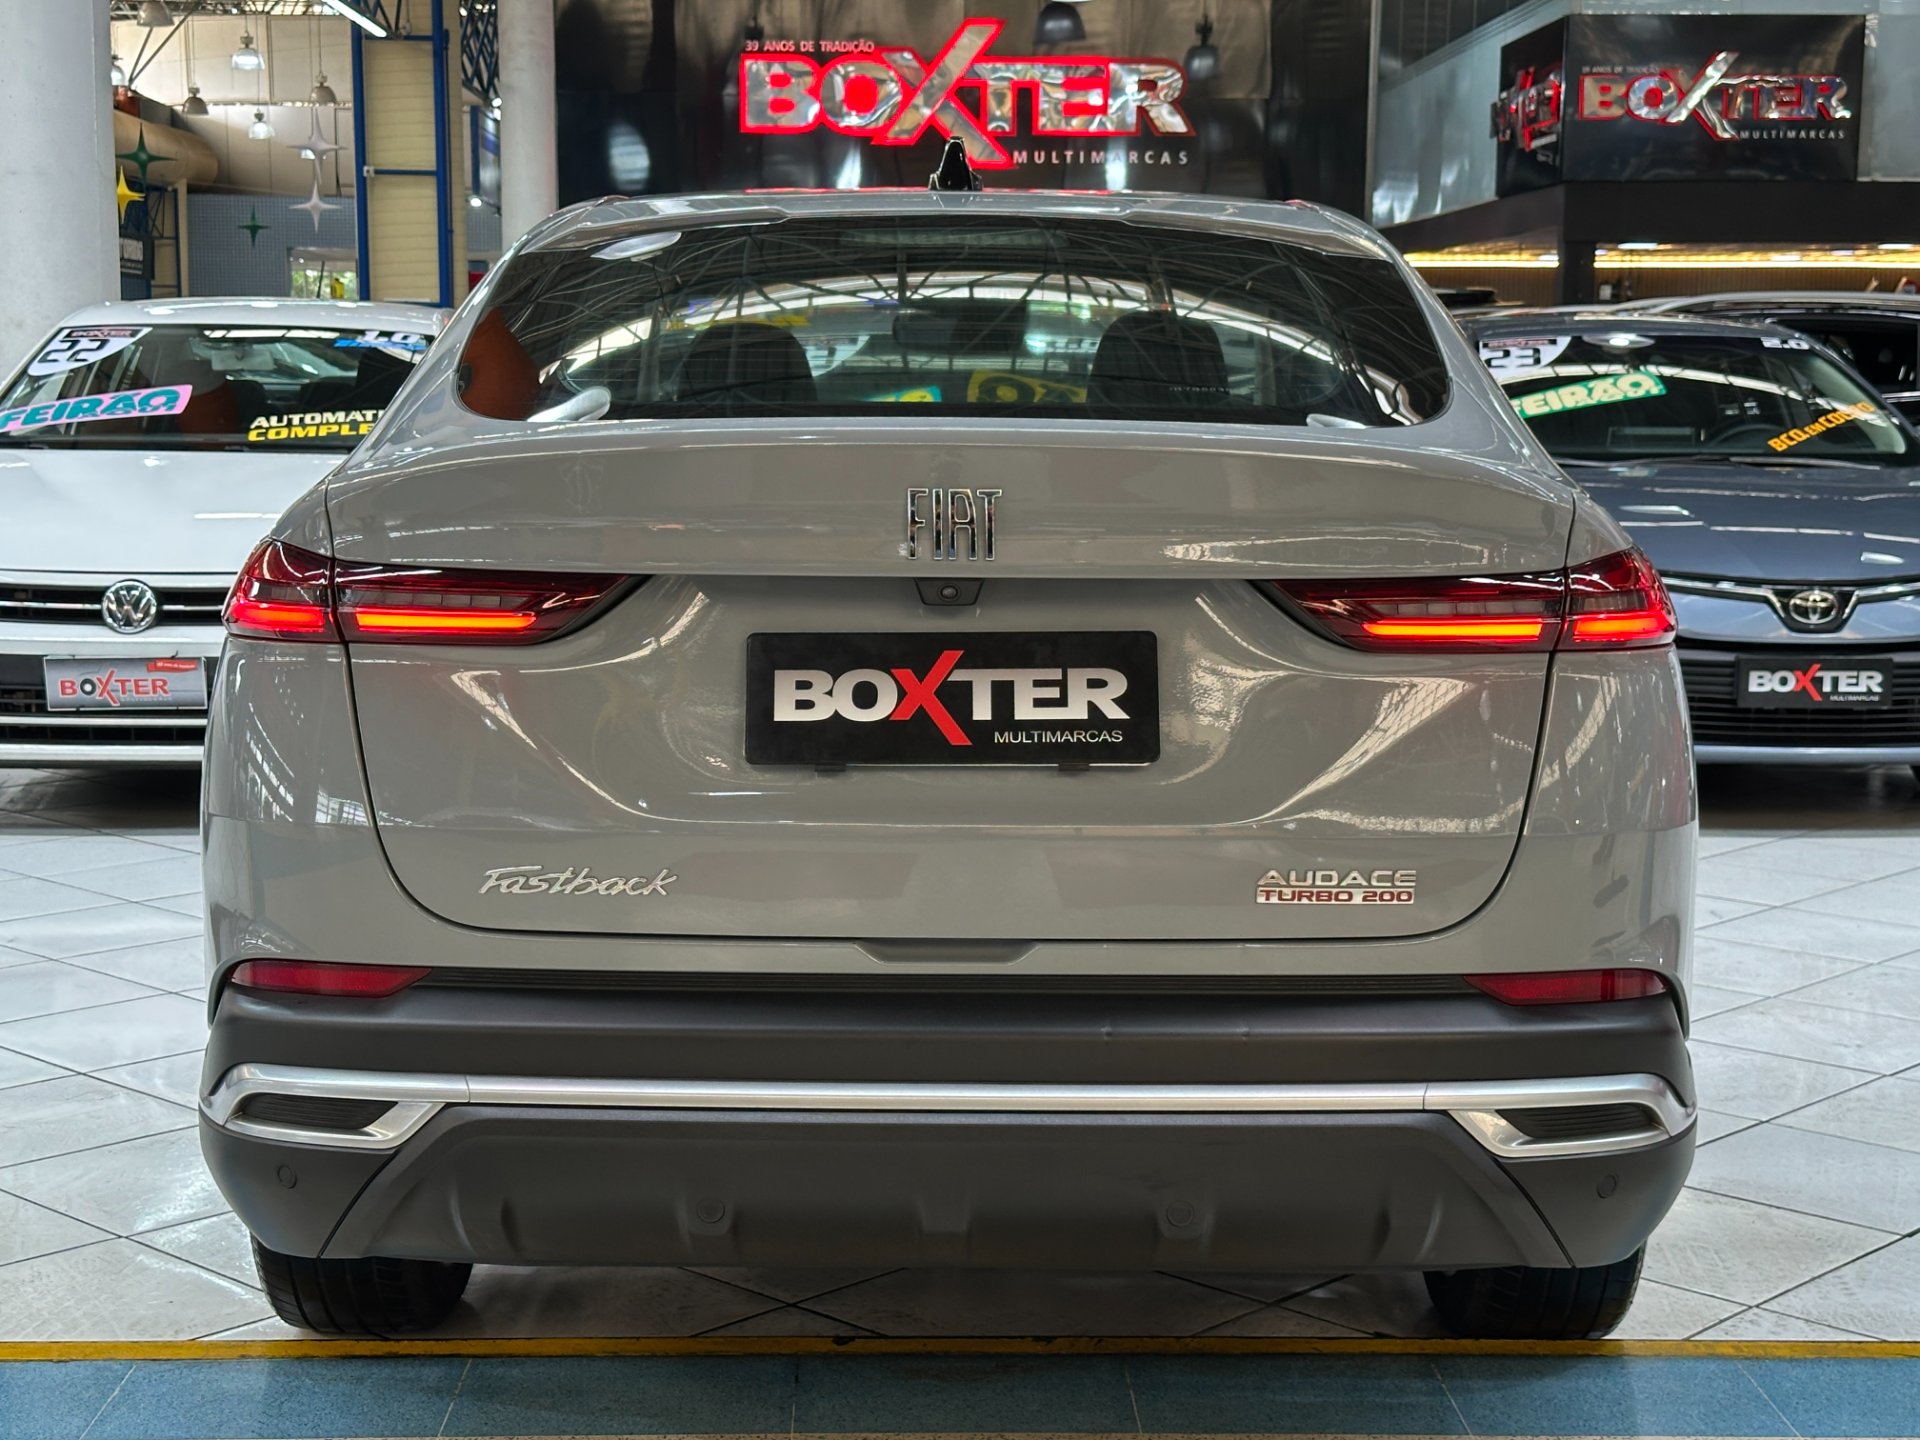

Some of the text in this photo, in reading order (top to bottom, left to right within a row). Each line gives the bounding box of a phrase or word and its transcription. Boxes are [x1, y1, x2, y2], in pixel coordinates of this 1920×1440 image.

[745, 38, 875, 54] 39 ANOS DE TRADIÇÃO
[741, 17, 1197, 169] BOXTER
[1577, 50, 1853, 141] BOXTER
[1739, 128, 1845, 140] MULTIMARCAS
[1013, 149, 1190, 166] MULTIMARCAS
[37, 339, 111, 364] 22
[1760, 337, 1810, 350] 2.0
[1485, 347, 1542, 368] 23
[906, 488, 1003, 561] FIAT
[59, 668, 171, 706] BOXTER
[1748, 663, 1884, 702] BOXTER
[773, 649, 1131, 746] BOXTER
[993, 729, 1124, 744] MULTIMARCAS
[477, 864, 679, 896] Fastback
[1256, 869, 1417, 886] AUDACE
[1258, 889, 1414, 903] TURBO 200
